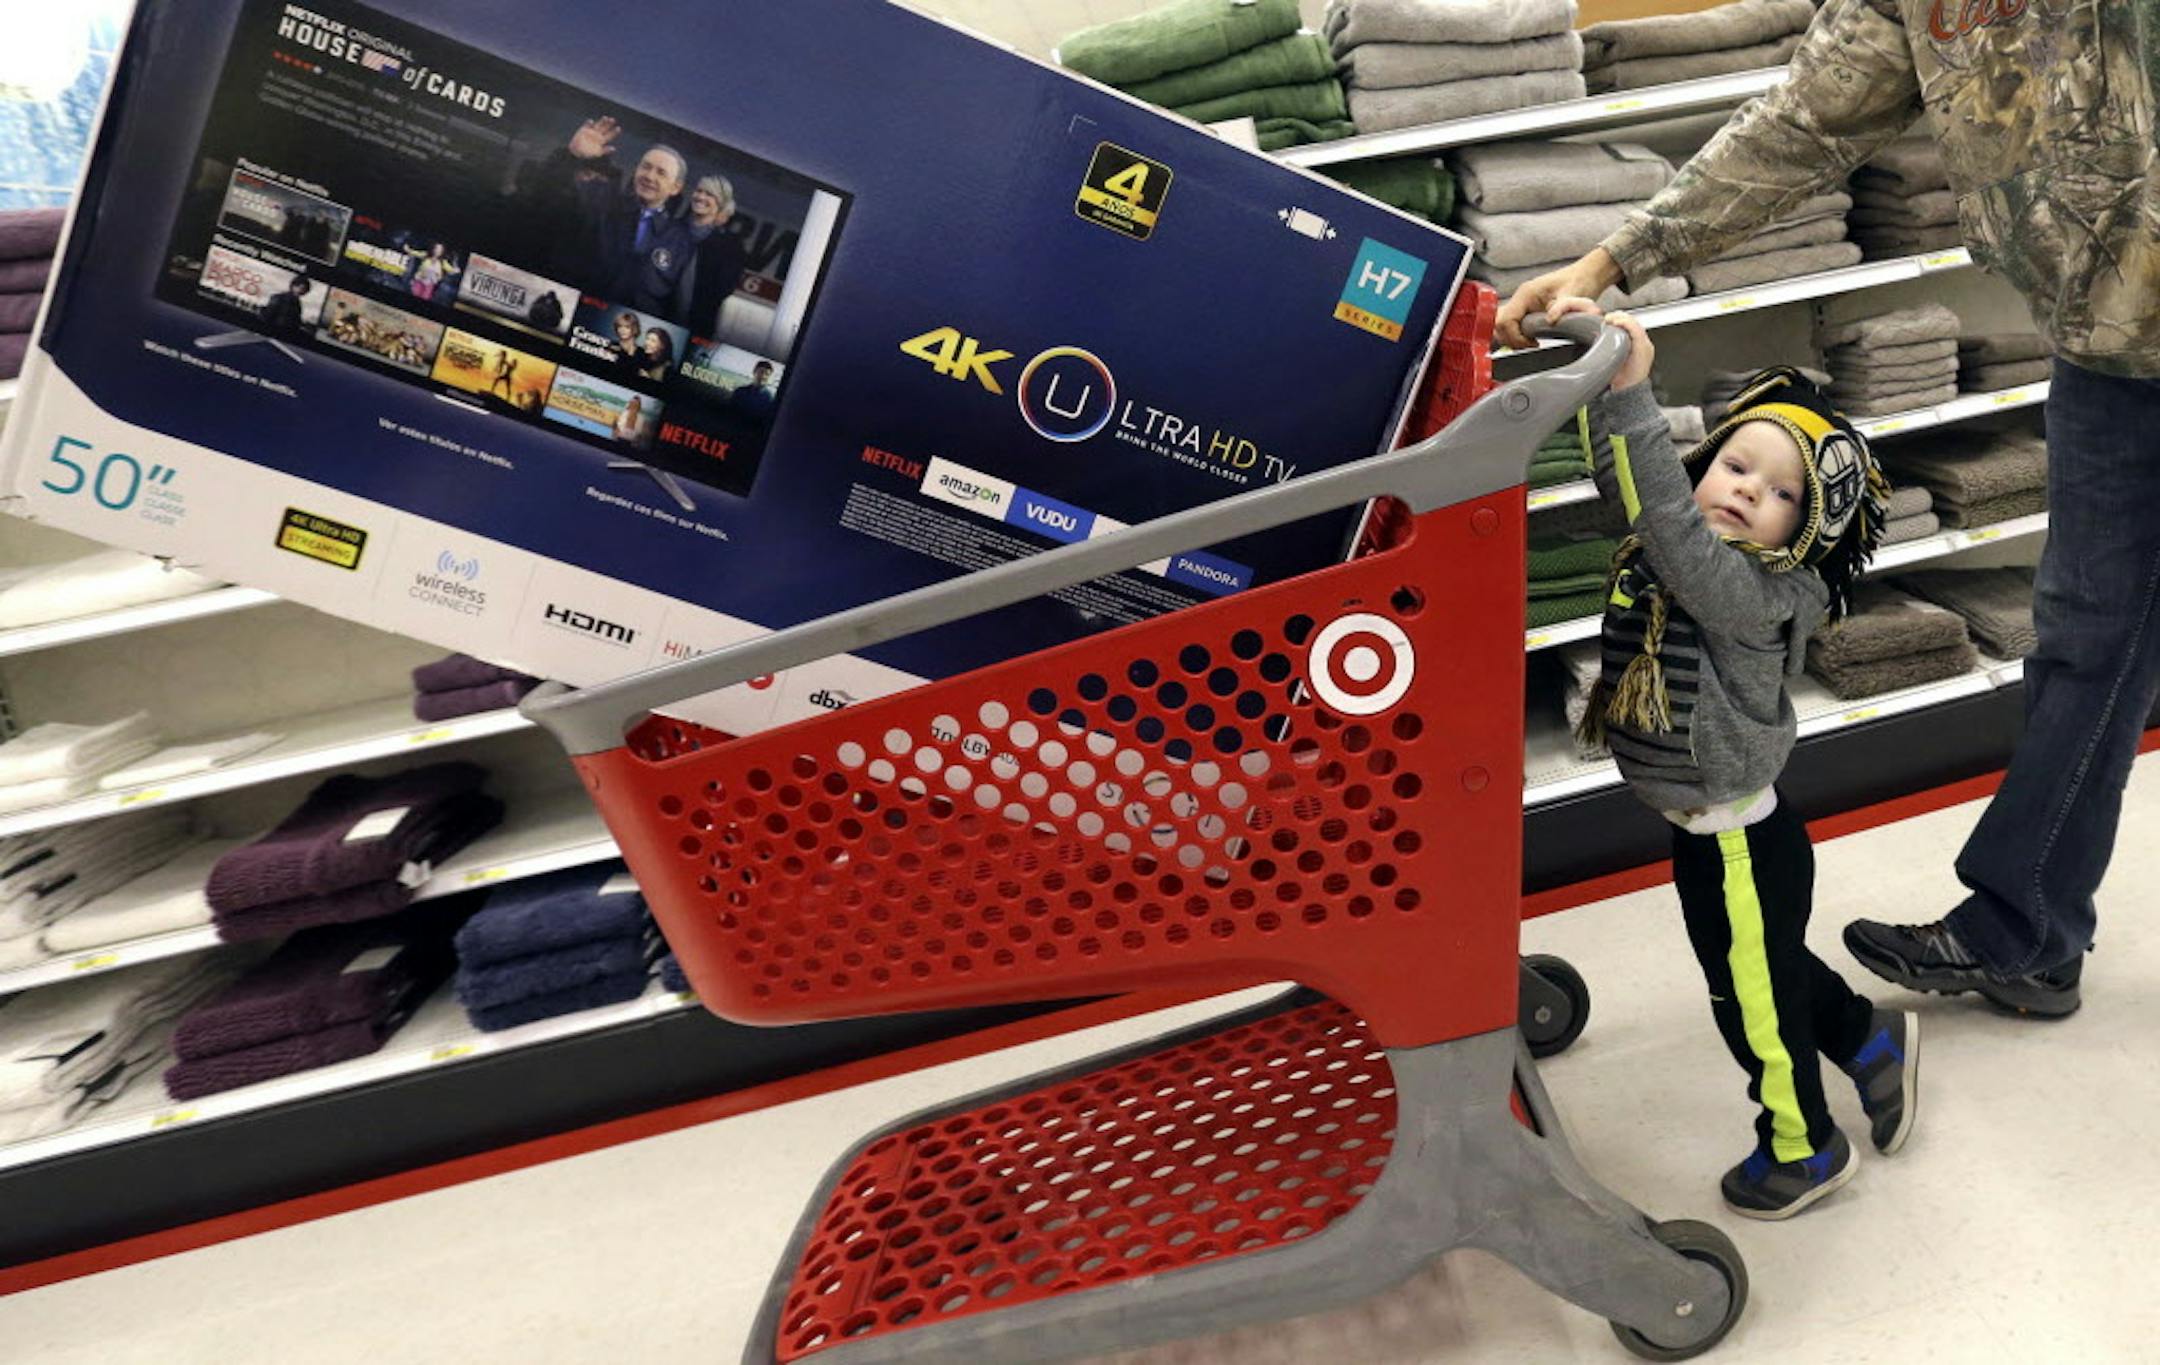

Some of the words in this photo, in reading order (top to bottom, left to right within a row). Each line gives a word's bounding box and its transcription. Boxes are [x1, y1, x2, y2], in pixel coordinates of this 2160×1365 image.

[284, 3, 347, 36] NETFLIX
[347, 27, 415, 63] ORIGINAL
[277, 14, 363, 64] HOUSE
[402, 65, 429, 91] of
[425, 76, 506, 118] CARDS
[1103, 161, 1152, 207] 4
[469, 271, 527, 309] VIRUNGA
[1357, 259, 1412, 301] H7
[1343, 307, 1394, 335] SERIES
[143, 338, 180, 359] Watch
[899, 326, 1015, 395] 4K
[1206, 429, 1259, 470] HD
[1264, 453, 1298, 484] TV
[659, 421, 732, 462] NETFLIX
[1114, 429, 1148, 450] BRING
[1149, 441, 1171, 457] THE
[1171, 450, 1208, 471] WORLD
[1209, 464, 1248, 485] CLOSER
[860, 444, 924, 482] NETFLIX
[938, 472, 1001, 505] amazon
[1025, 501, 1078, 532] VUDU
[415, 573, 487, 605] wireless
[1177, 557, 1240, 588] PANDORA
[407, 585, 485, 617] CONNECT
[545, 602, 636, 645] HDMI
